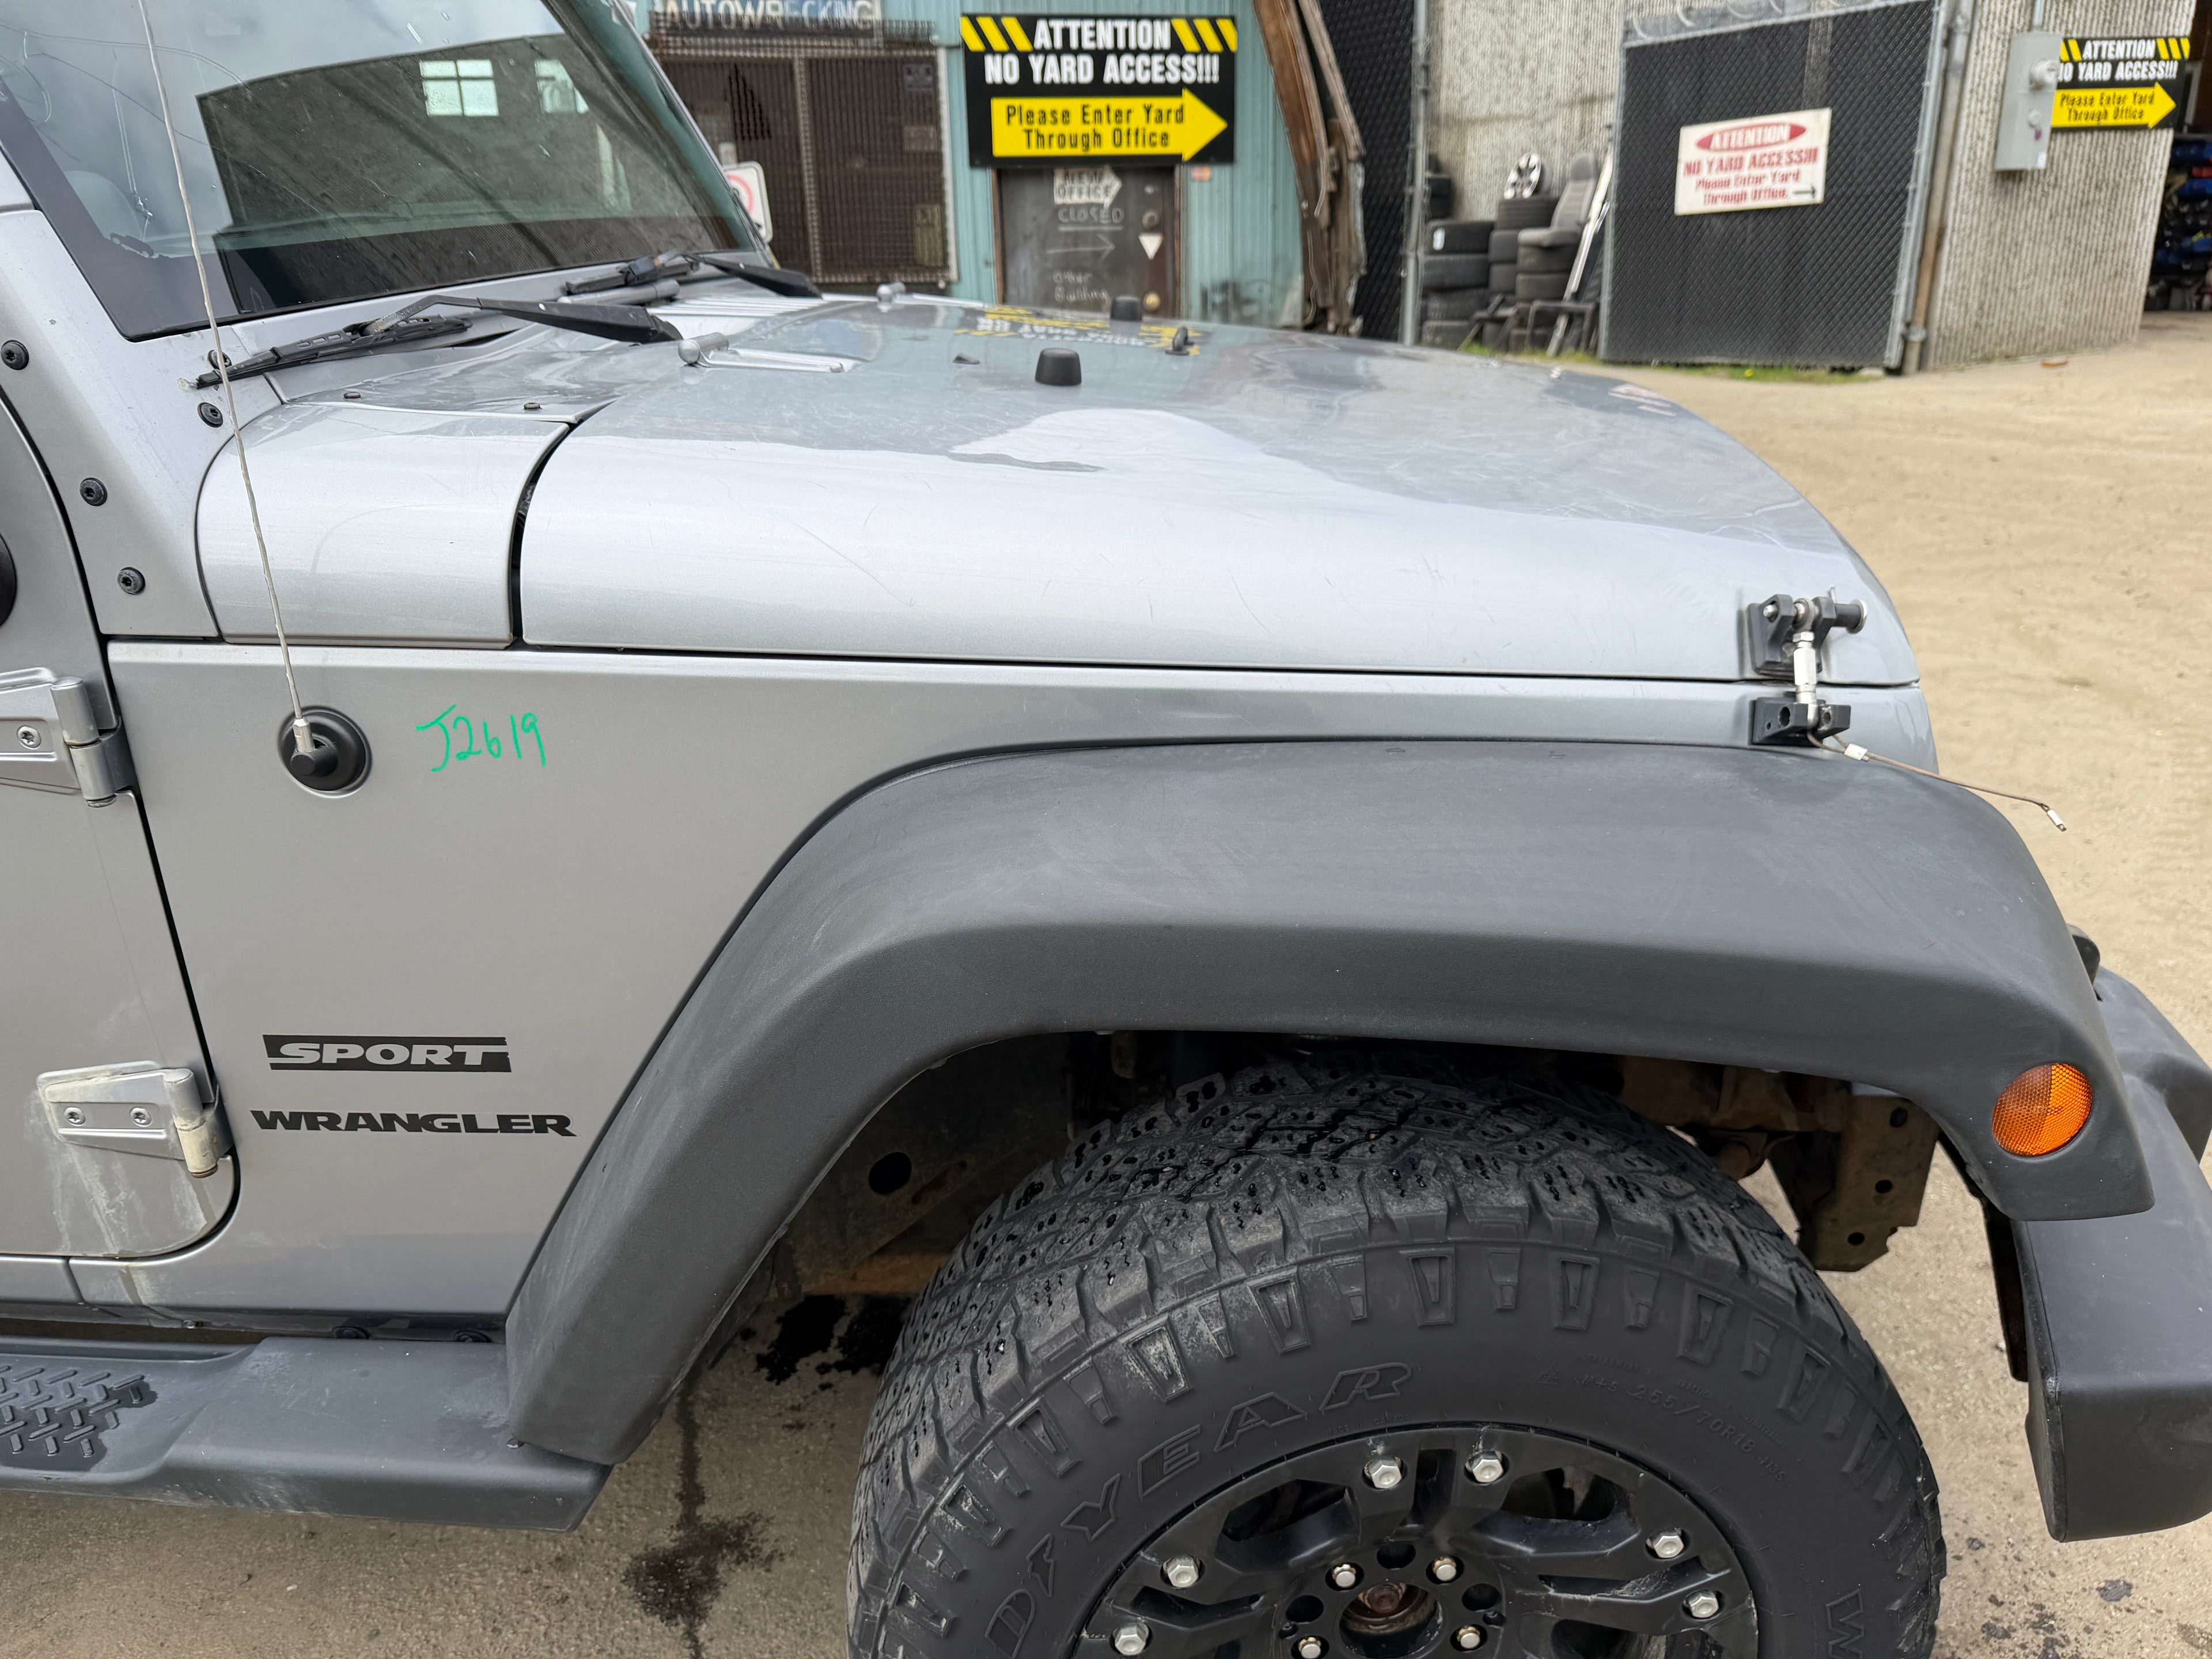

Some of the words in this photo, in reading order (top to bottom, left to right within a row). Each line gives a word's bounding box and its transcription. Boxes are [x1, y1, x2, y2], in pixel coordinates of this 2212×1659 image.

[1034, 18, 1171, 50] ATTENTION
[2082, 39, 2156, 60] ATTENTION
[984, 53, 1020, 84] NO
[1028, 54, 1094, 84] YARD
[1103, 53, 1219, 84] ACCESS!!!
[2078, 62, 2112, 81] YARD
[2115, 60, 2179, 80] ACCESS!!!
[2060, 93, 2094, 106] Please
[2099, 92, 2127, 105] Enter
[2133, 90, 2154, 104] Yard
[1006, 104, 1070, 125] Please
[1082, 104, 1132, 124] Enter
[1143, 104, 1184, 124] Yard
[2068, 108, 2108, 122] Through
[2113, 107, 2144, 120] Office
[1024, 128, 1102, 152] Through
[1113, 127, 1169, 148] Office
[1711, 124, 1788, 149] ATTENTION
[1684, 161, 1701, 175] NO
[1706, 156, 1744, 173] YARD
[1058, 206, 1124, 224] CLOSED
[415, 704, 547, 772] J2619
[268, 1041, 508, 1066] SPORT
[250, 1109, 578, 1137] WRANGLER
